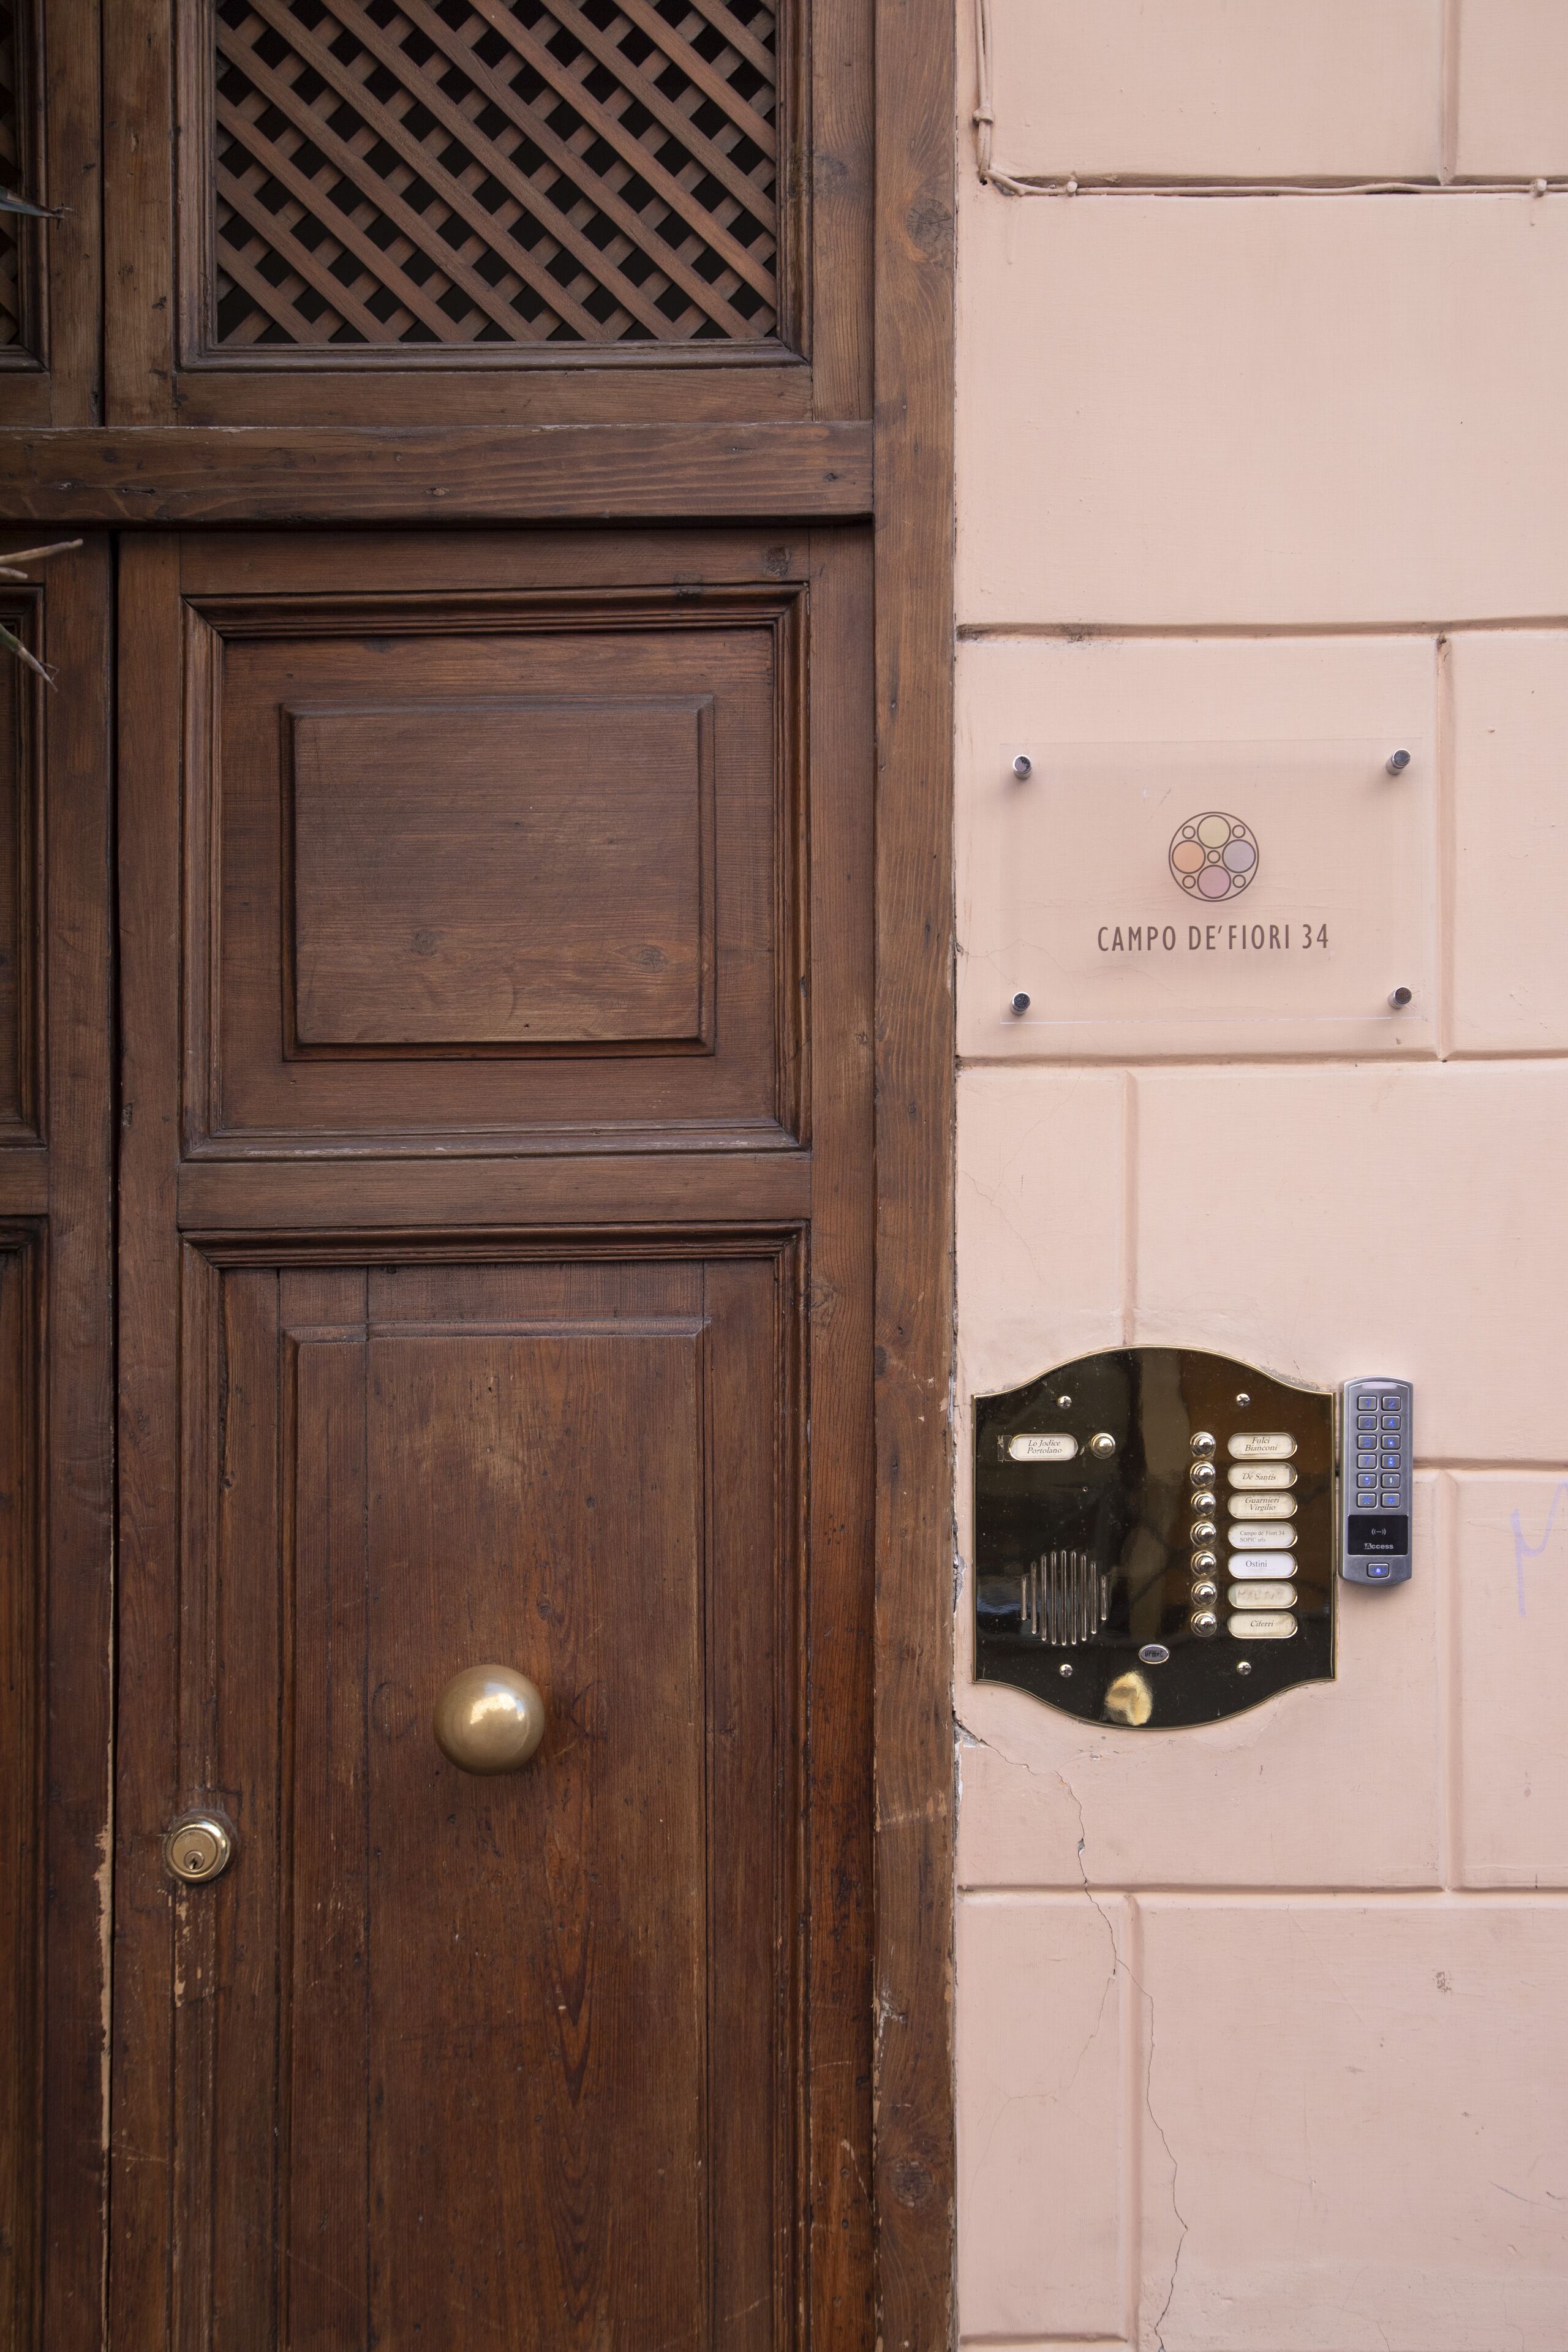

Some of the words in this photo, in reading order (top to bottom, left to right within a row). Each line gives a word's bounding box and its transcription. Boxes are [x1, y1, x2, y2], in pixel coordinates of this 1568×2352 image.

[1098, 925, 1176, 951] CAMPO
[1302, 924, 1329, 949] 34
[1365, 1398, 1371, 1408] 1
[1388, 1399, 1395, 1408] 2
[1365, 1418, 1371, 1428] 3
[1387, 1417, 1395, 1428] 4
[1038, 1439, 1061, 1448] Jodice
[1363, 1437, 1371, 1447] 5
[1387, 1437, 1395, 1447] 6
[1363, 1456, 1371, 1466] 7
[1387, 1456, 1395, 1466] 8
[1363, 1476, 1371, 1486] 9
